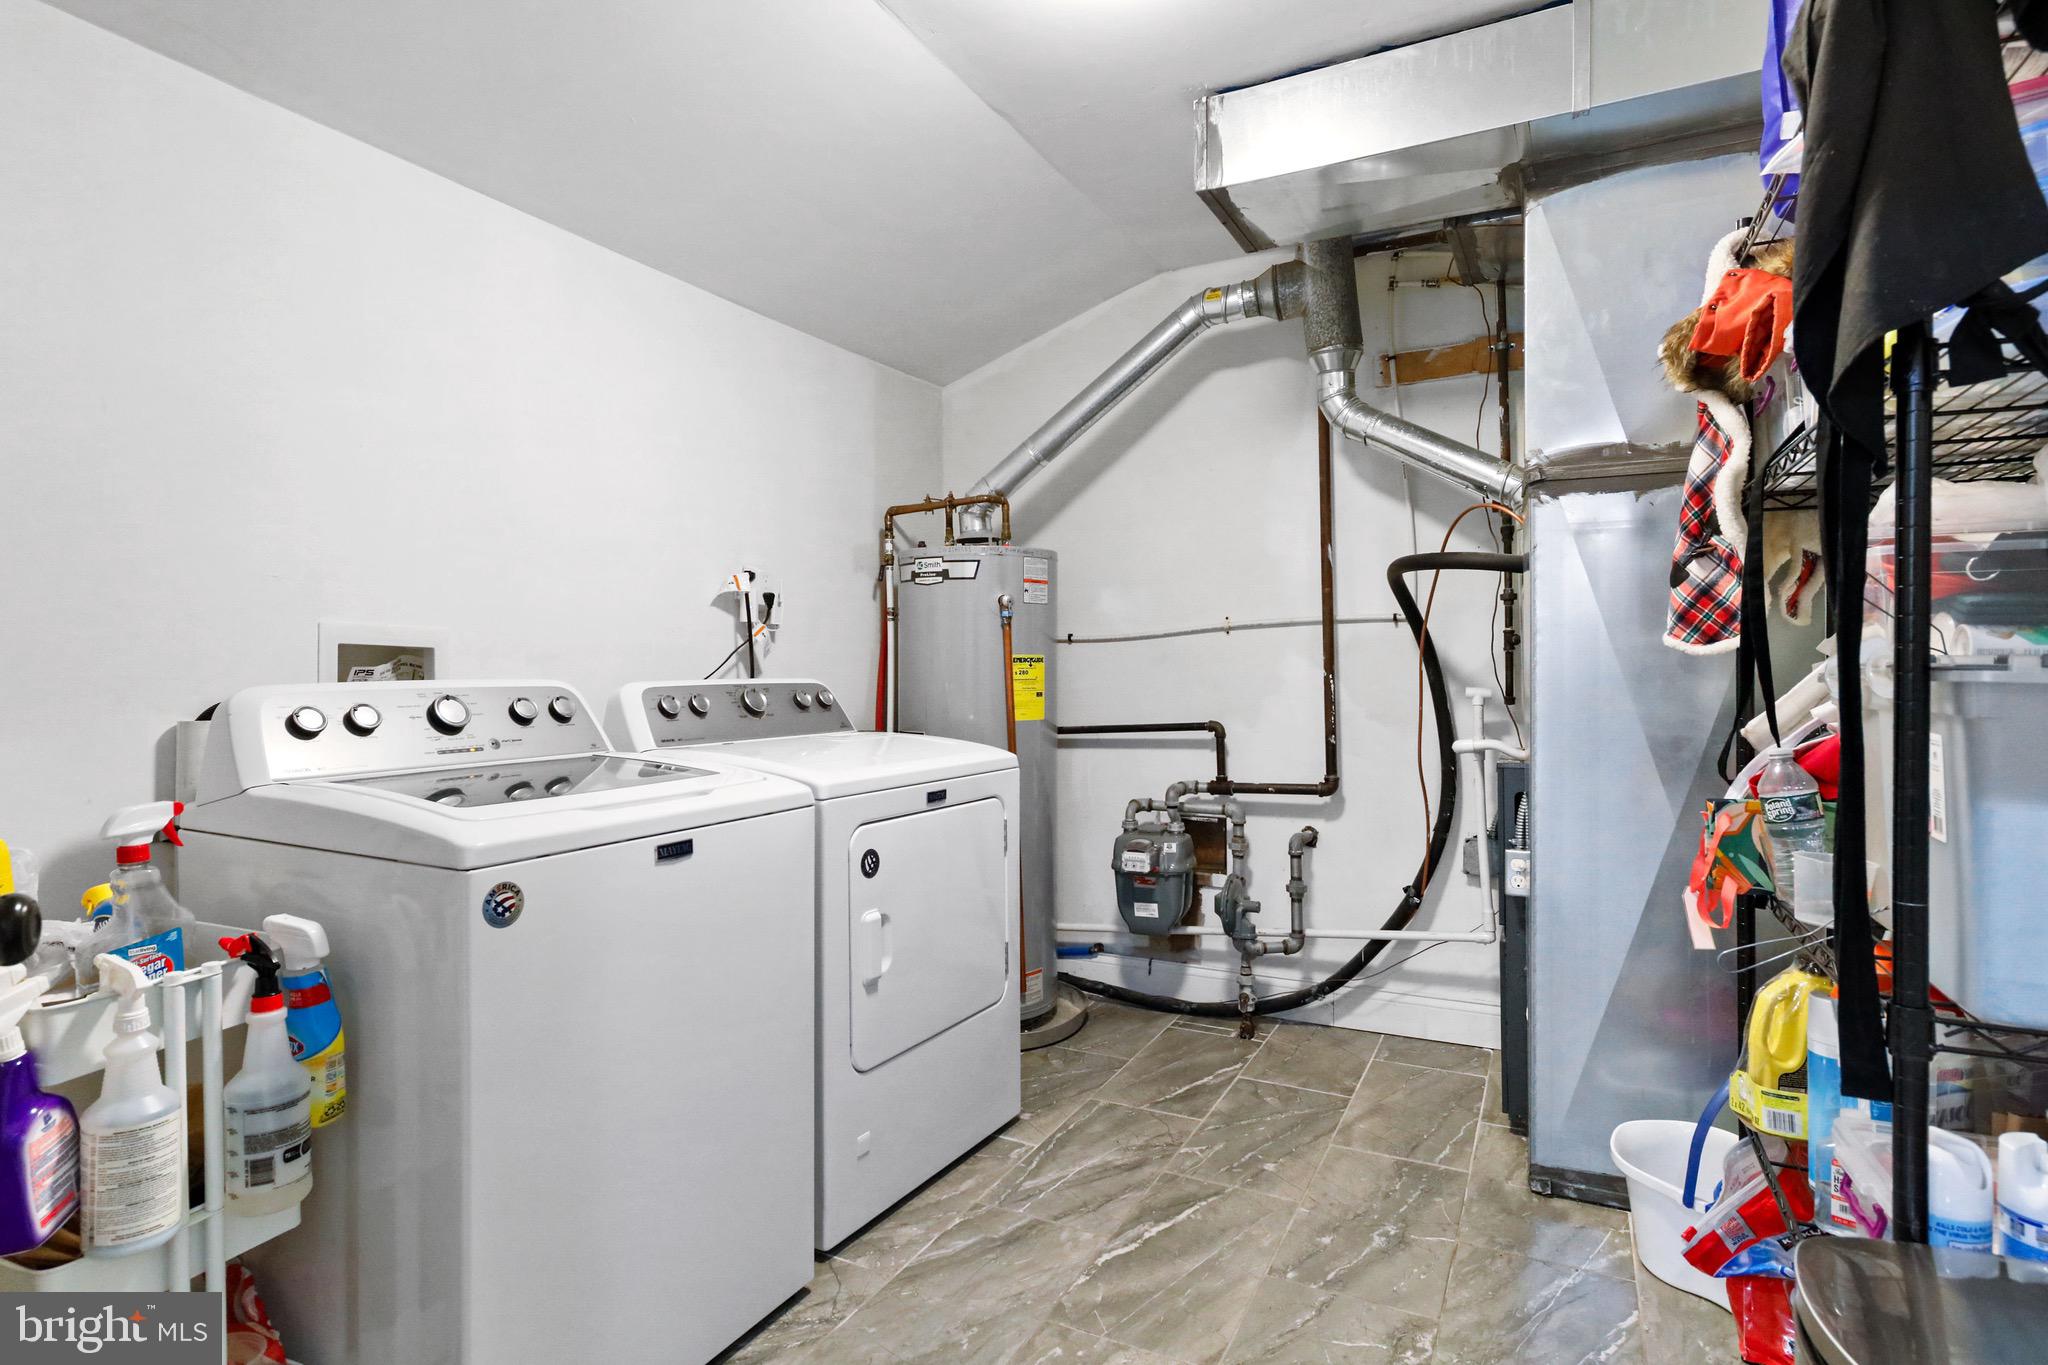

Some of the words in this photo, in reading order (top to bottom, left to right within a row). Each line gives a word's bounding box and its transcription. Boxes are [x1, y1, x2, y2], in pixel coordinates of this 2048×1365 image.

[924, 561, 941, 569] Smith
[1765, 798, 1792, 812] Poland
[1766, 806, 1795, 820] Spring
[141, 957, 167, 975] egar
